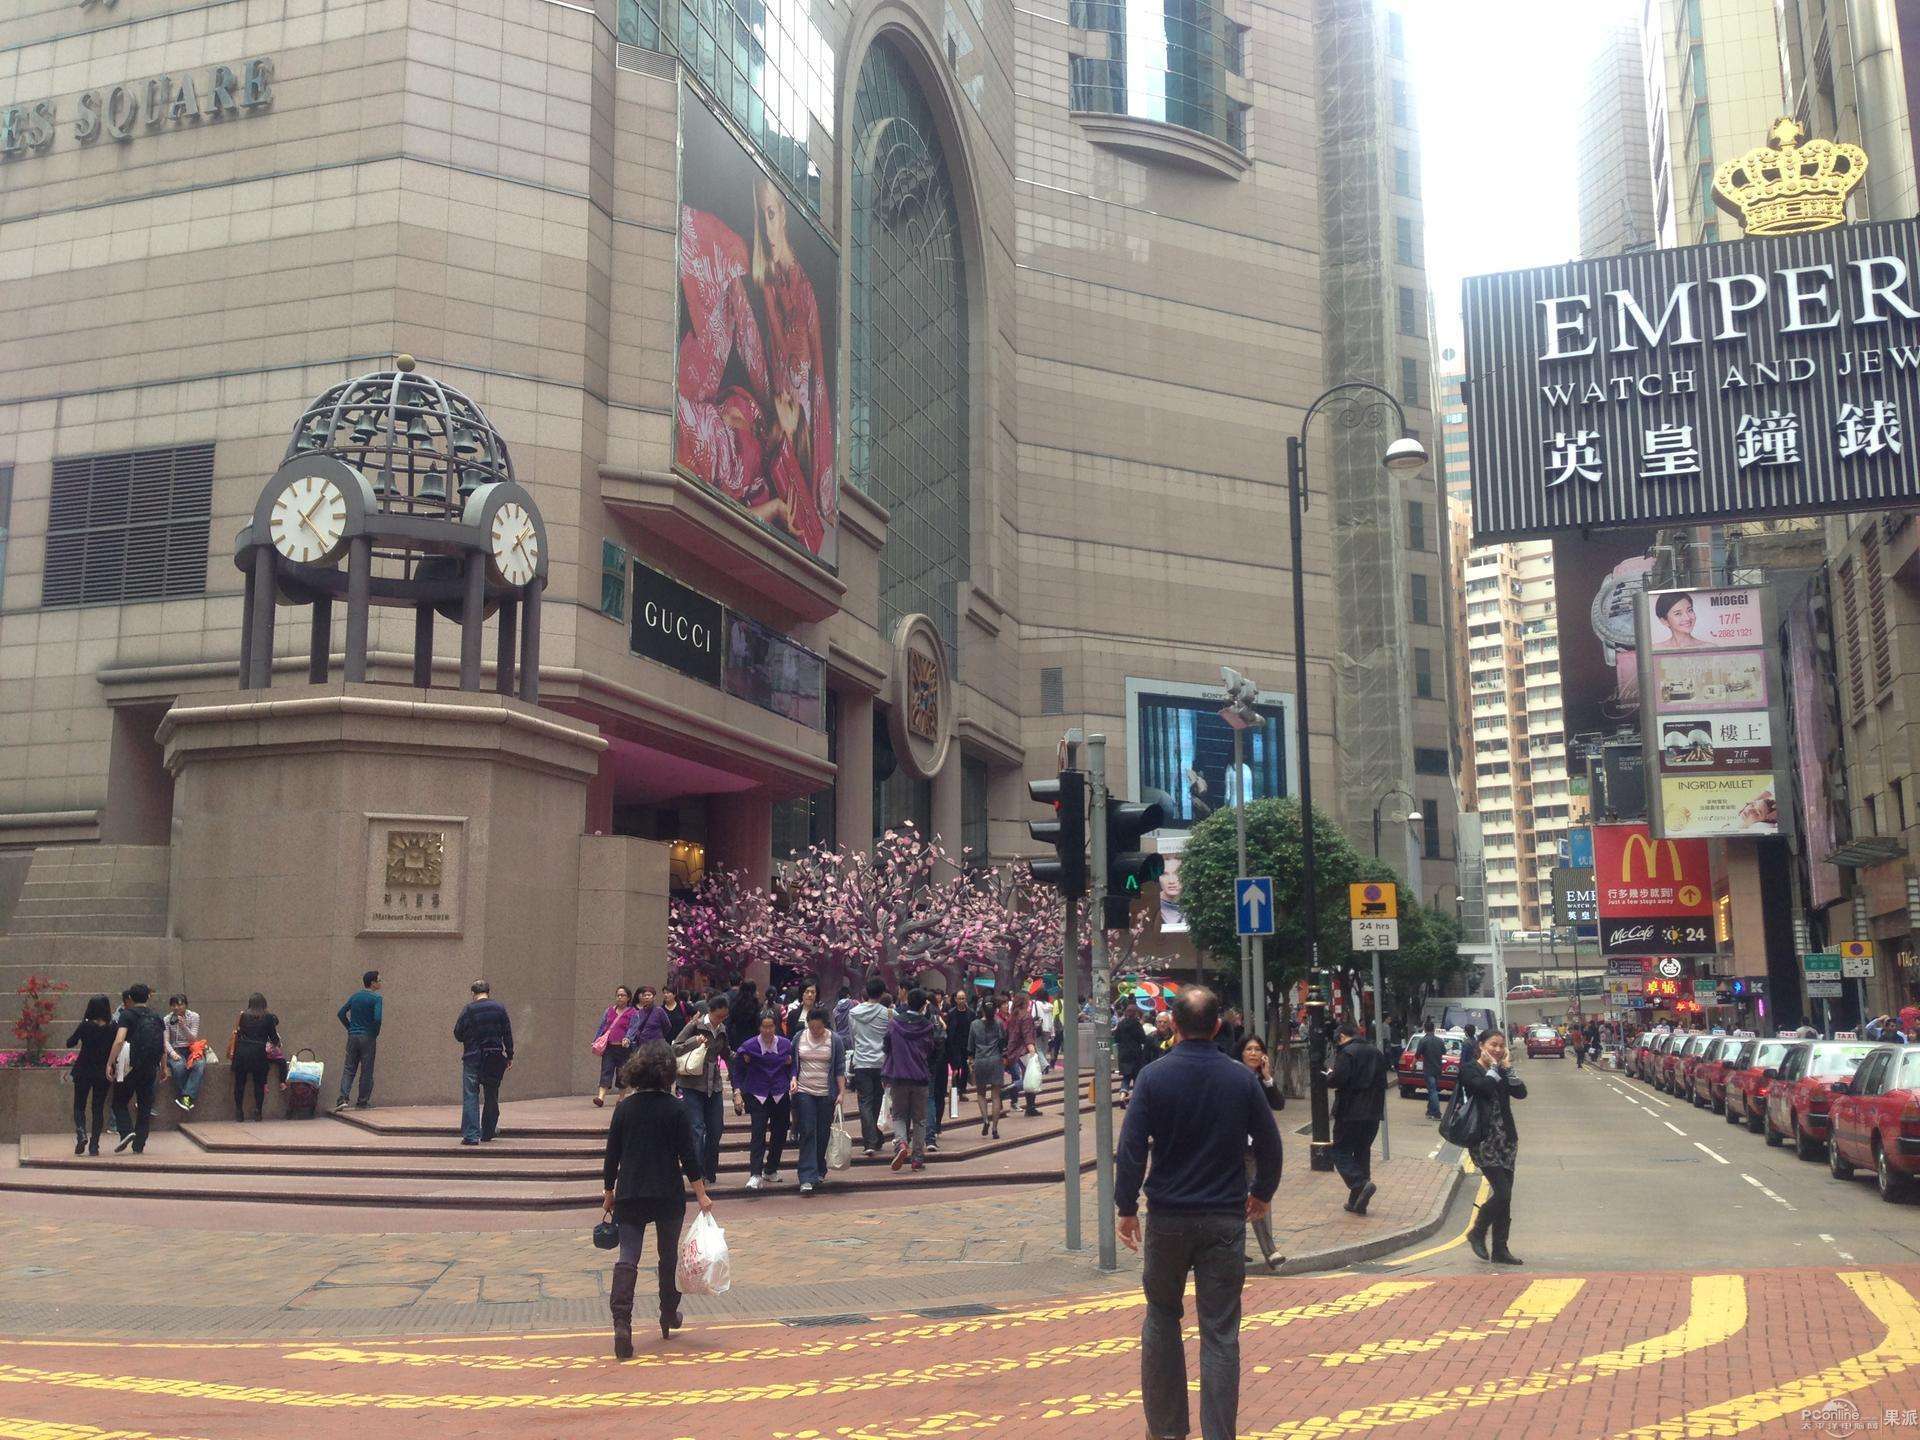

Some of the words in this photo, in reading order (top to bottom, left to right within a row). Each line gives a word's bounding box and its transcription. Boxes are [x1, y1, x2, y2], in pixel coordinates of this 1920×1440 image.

[74, 56, 275, 146] SQUARE
[1535, 255, 1920, 361] EMPER
[1540, 369, 1698, 408] WATCH
[1720, 356, 1817, 390] AND
[1543, 400, 1903, 488] 英皇鐘錶
[645, 601, 710, 652] GUCCI
[1718, 612, 1741, 625] 17/F
[1719, 723, 1761, 742] 樓上
[1733, 749, 1750, 758] 7/F
[1678, 780, 1717, 790] INGRID
[1719, 779, 1753, 789] MILLET
[1360, 922, 1372, 930] 24
[1376, 922, 1390, 930] hrs
[1362, 934, 1389, 947] 全日
[1686, 928, 1707, 941] 24
